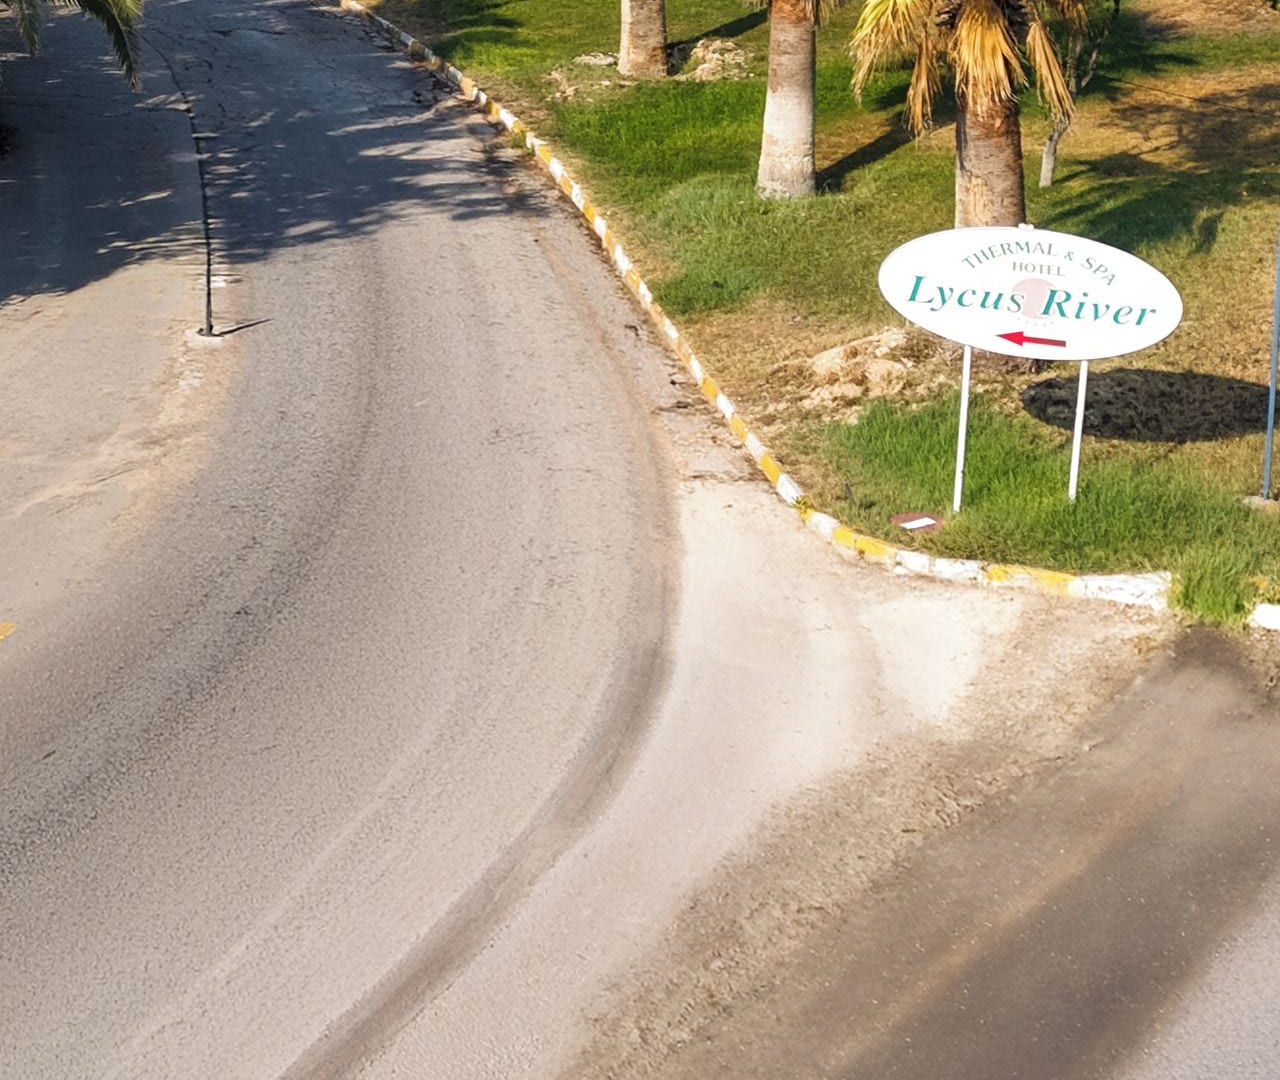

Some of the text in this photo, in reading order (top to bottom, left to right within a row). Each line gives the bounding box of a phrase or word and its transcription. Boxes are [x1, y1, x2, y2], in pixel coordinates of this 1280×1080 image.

[961, 240, 1117, 287] THERMAL & SPA
[1011, 260, 1066, 278] HOTEL
[907, 274, 1157, 327] Lycus River
